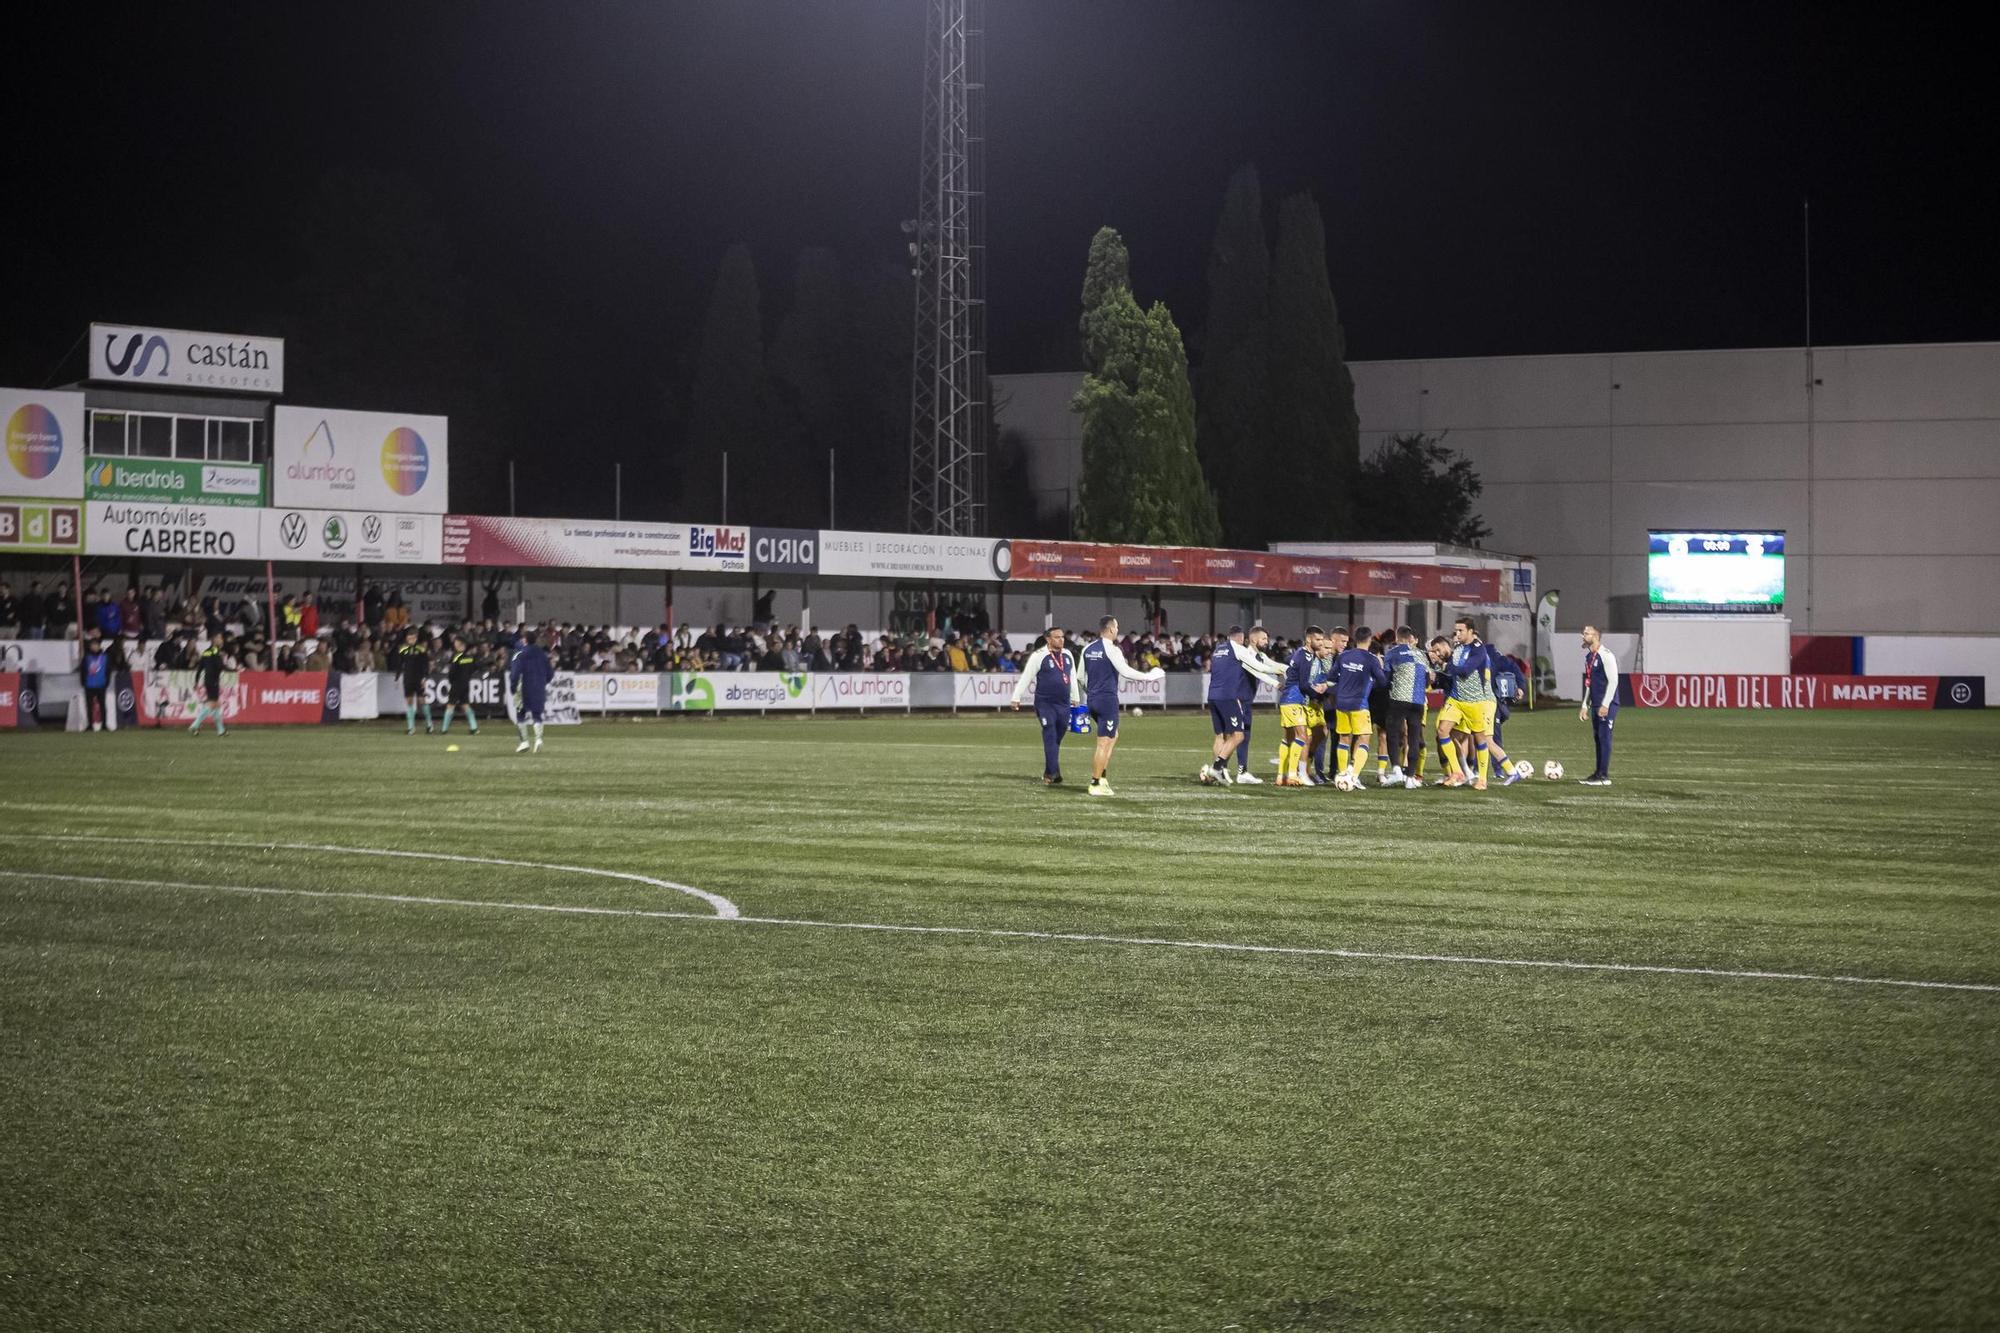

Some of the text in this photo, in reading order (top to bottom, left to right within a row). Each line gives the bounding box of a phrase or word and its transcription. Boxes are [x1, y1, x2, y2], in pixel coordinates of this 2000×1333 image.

[187, 342, 270, 370] castán
[185, 373, 271, 388] asesores
[115, 467, 185, 489] Iberdrola
[287, 461, 355, 482] alumbra
[103, 504, 207, 527] Automóviles
[125, 527, 235, 556] CABRERO
[690, 527, 746, 557] BigMat
[824, 541, 987, 558] MUEBLES DECORACIÓN COCINAS
[1028, 552, 1063, 563] MONZÓN
[1119, 554, 1151, 565] MONZÓN
[1206, 557, 1236, 568] MONZÓN
[1292, 564, 1321, 575] MONZÓN
[424, 672, 500, 704] SORÍE
[839, 673, 903, 697] alumbra
[978, 676, 1036, 695] aluma
[1119, 678, 1160, 694] umbra
[1675, 676, 1927, 709] COPA DEL REY MAPFRE
[261, 689, 321, 704] MAPFRE
